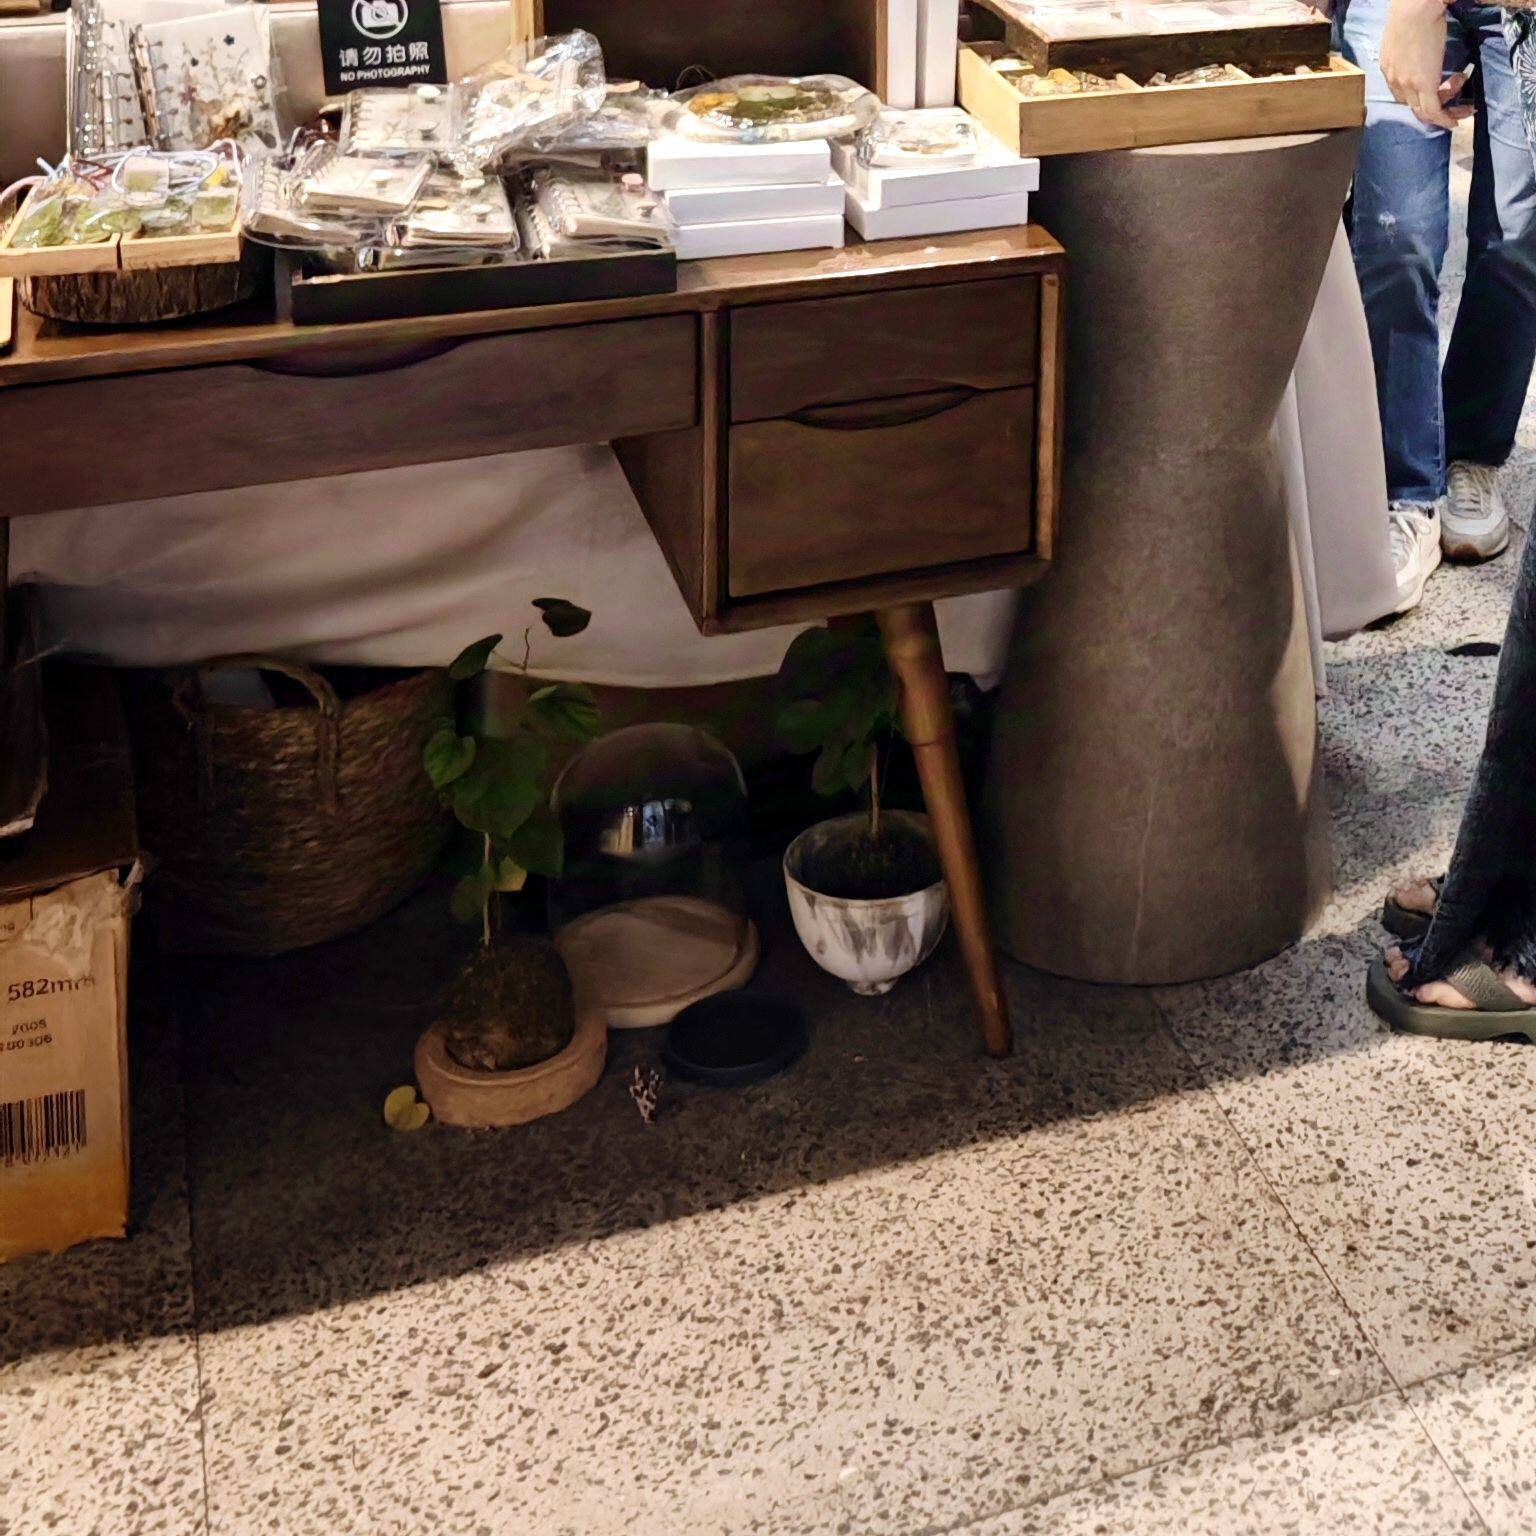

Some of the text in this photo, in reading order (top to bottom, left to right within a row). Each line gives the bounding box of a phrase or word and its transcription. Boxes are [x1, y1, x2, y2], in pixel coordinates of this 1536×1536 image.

[339, 41, 430, 67] 请勿拍照
[340, 64, 430, 82] NO PHOTOGRAPHY
